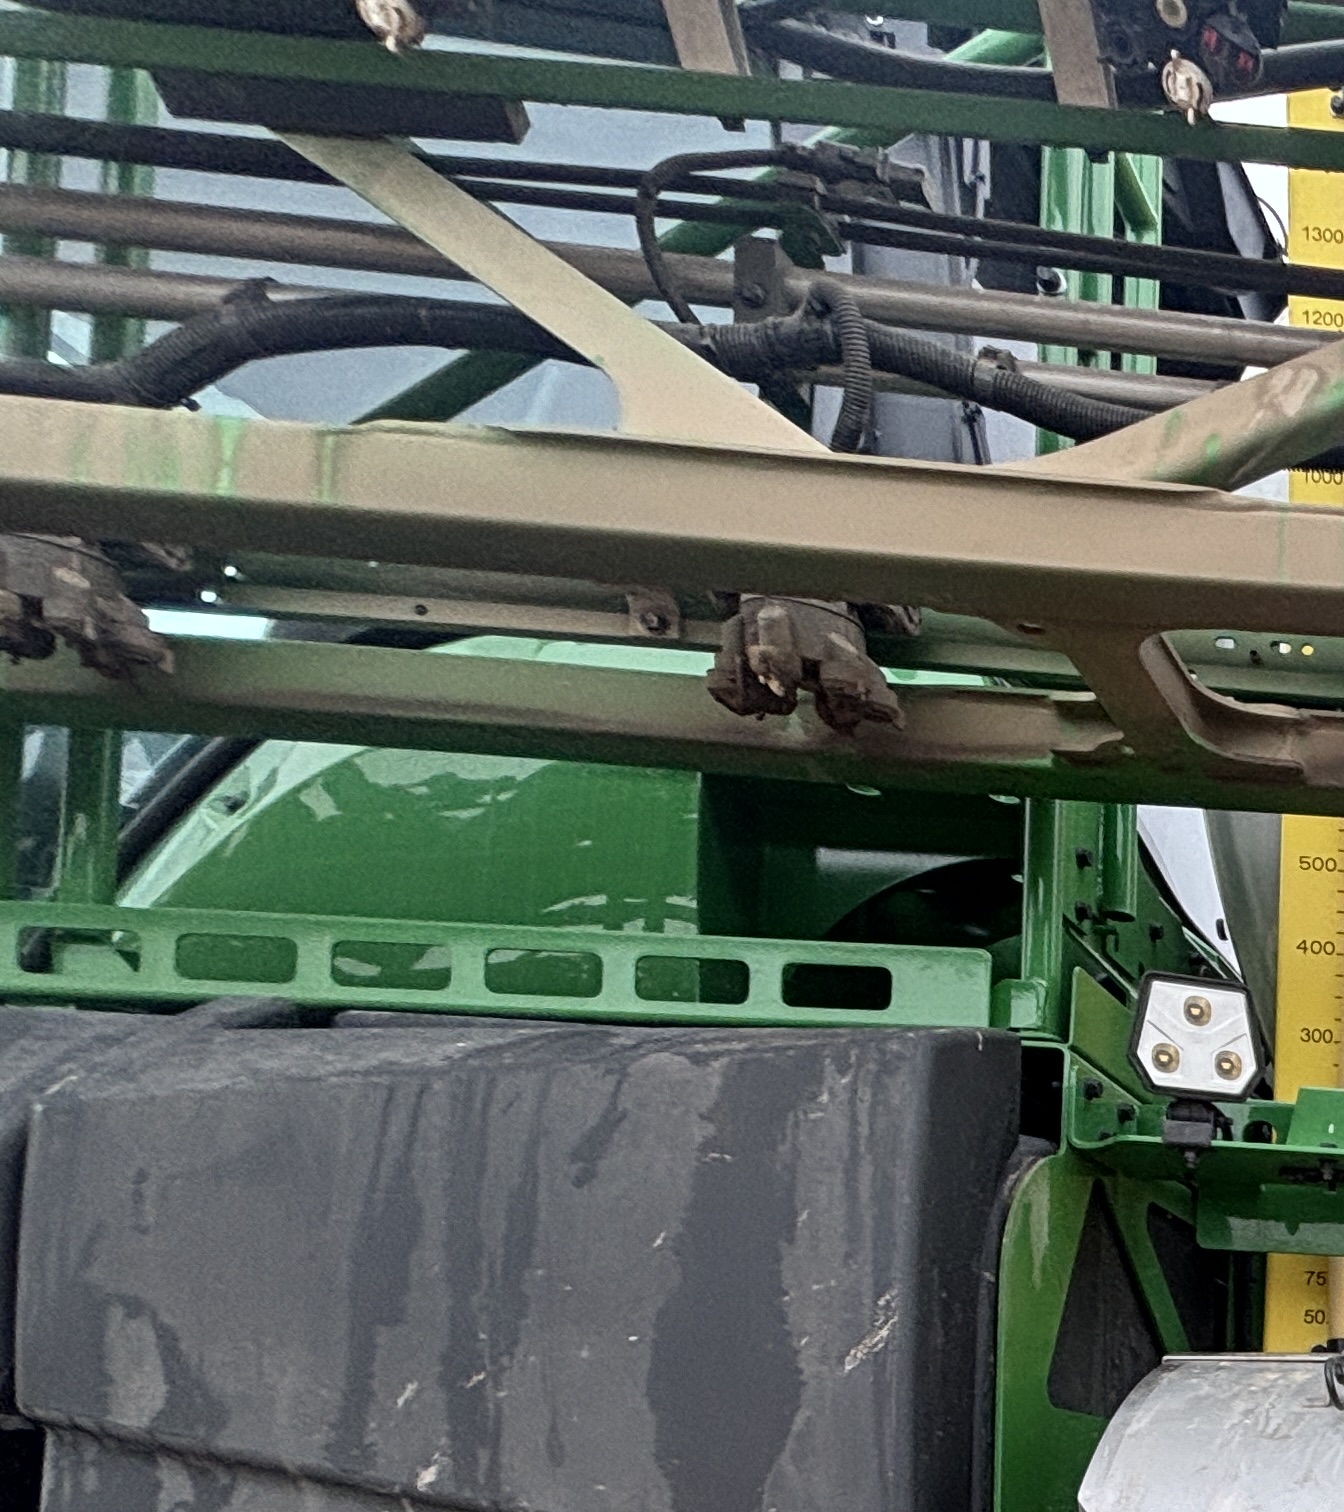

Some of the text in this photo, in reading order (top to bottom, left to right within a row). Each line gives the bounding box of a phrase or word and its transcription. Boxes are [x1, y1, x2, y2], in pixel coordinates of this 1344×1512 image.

[1302, 226, 1344, 245] 1300
[1302, 311, 1344, 329] 1200
[1299, 856, 1337, 872] 500
[1296, 940, 1335, 955] 400
[1300, 1028, 1333, 1043] 300
[1304, 1270, 1327, 1286] 75
[1304, 1309, 1326, 1324] 50
